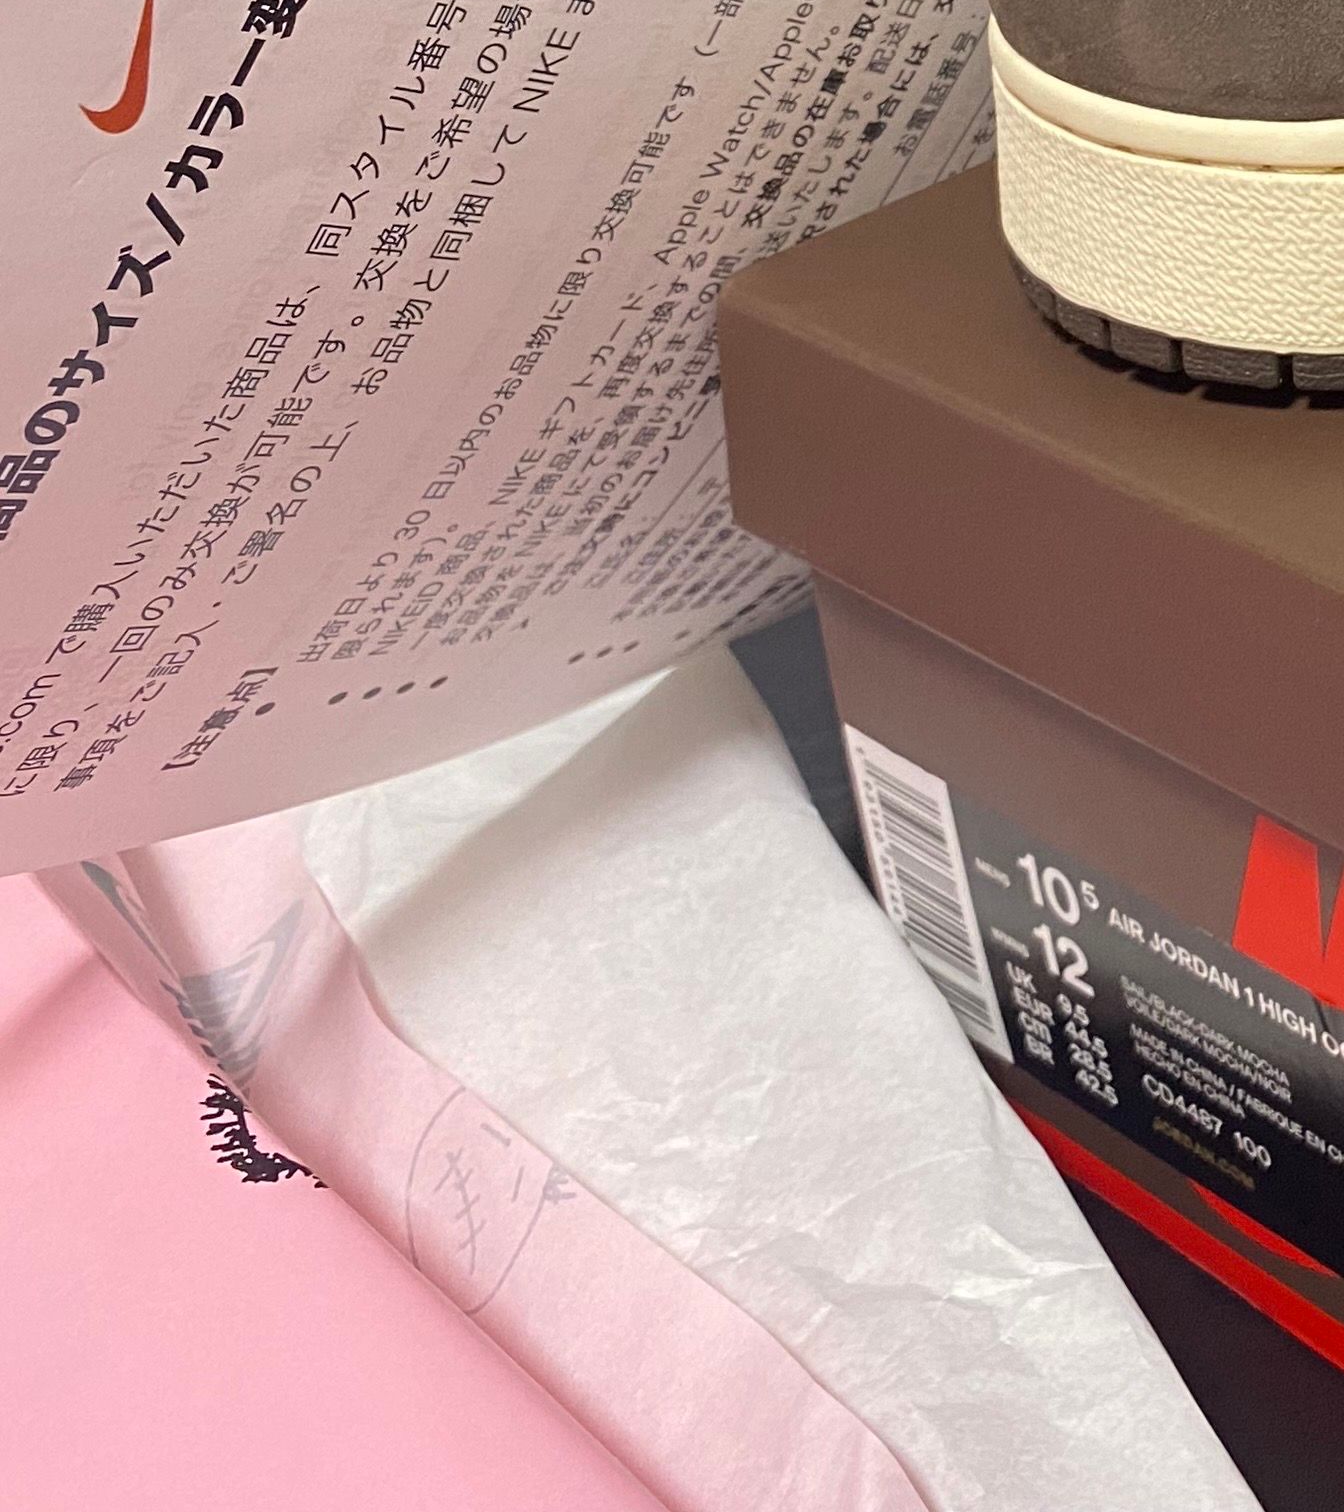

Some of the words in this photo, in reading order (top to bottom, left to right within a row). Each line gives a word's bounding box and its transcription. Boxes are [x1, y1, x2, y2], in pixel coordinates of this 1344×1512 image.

[512, 20, 582, 119] NIKE
[1005, 961, 1037, 994] UK
[1032, 922, 1095, 999] 12
[1108, 906, 1146, 945] AIR
[1150, 929, 1241, 996] JORDAN
[1259, 993, 1318, 1044] HIGH
[1012, 986, 1054, 1026] EUR
